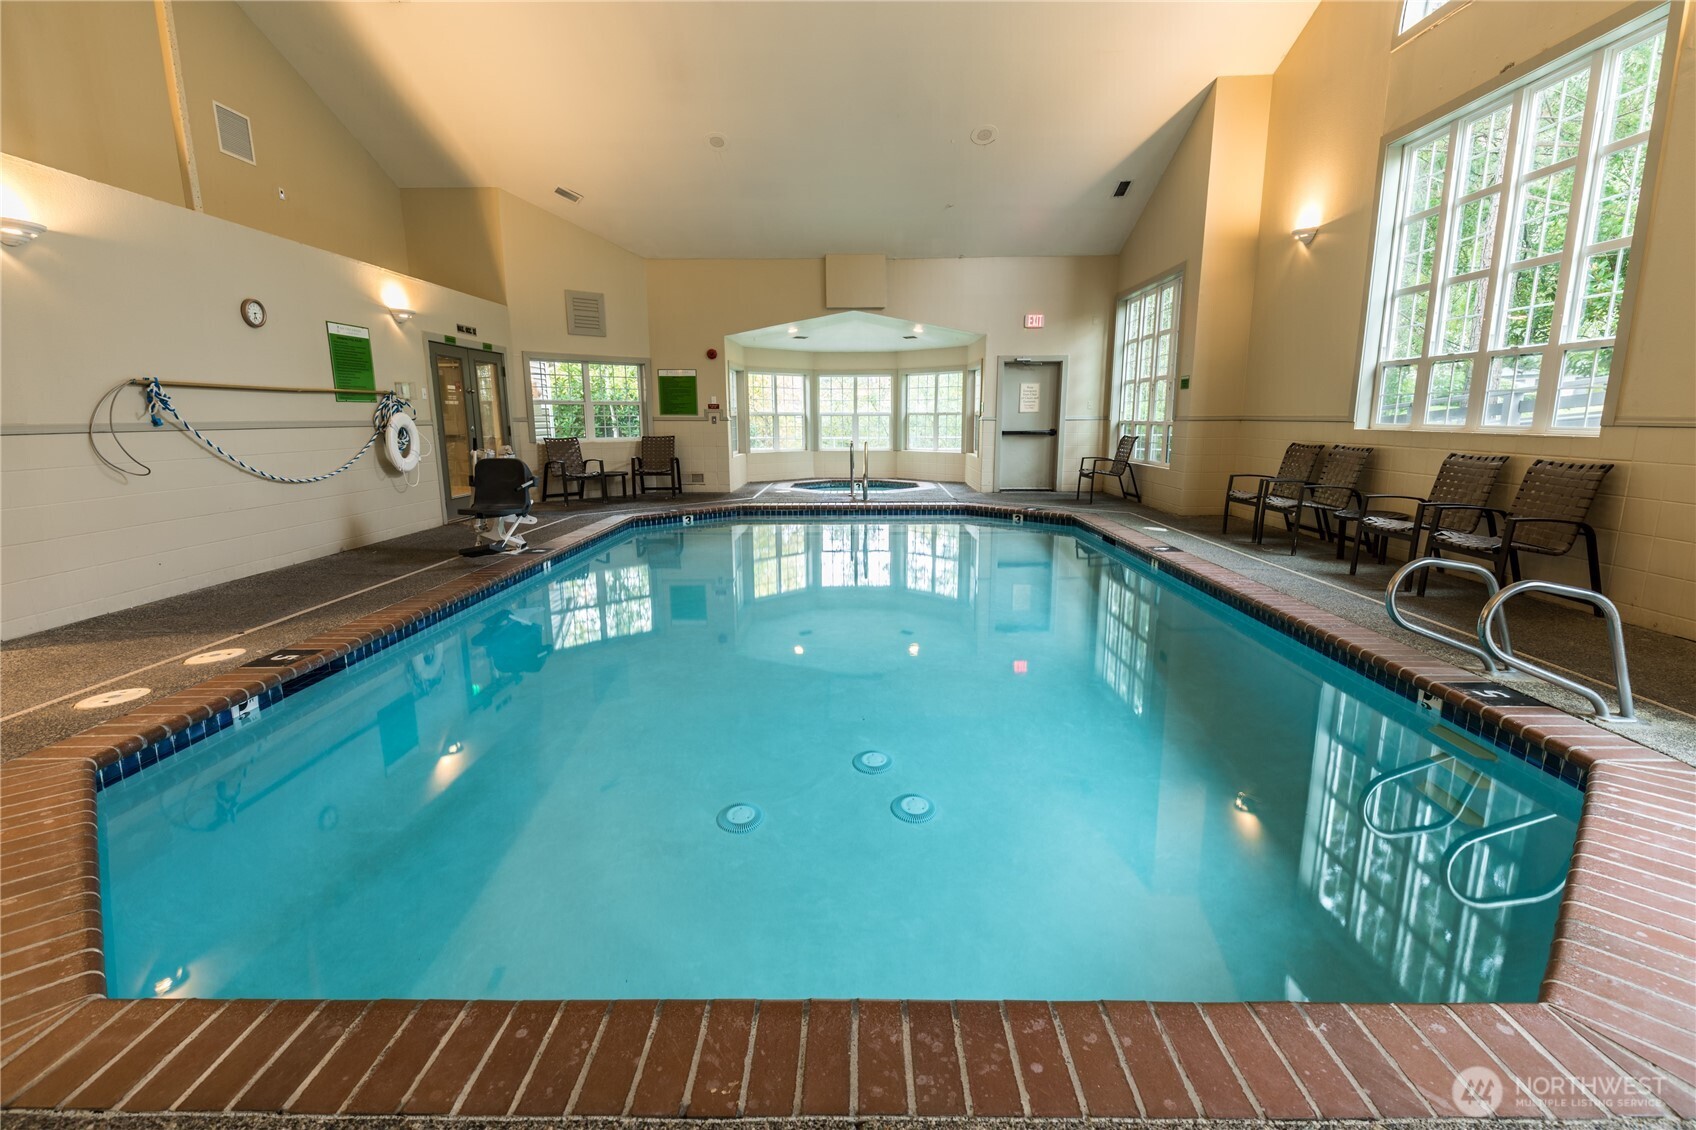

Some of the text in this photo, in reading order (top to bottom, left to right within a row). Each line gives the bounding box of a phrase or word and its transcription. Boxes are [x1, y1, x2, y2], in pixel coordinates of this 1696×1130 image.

[1028, 314, 1043, 327] EXIT
[685, 516, 692, 526] 3
[1014, 514, 1021, 525] 3
